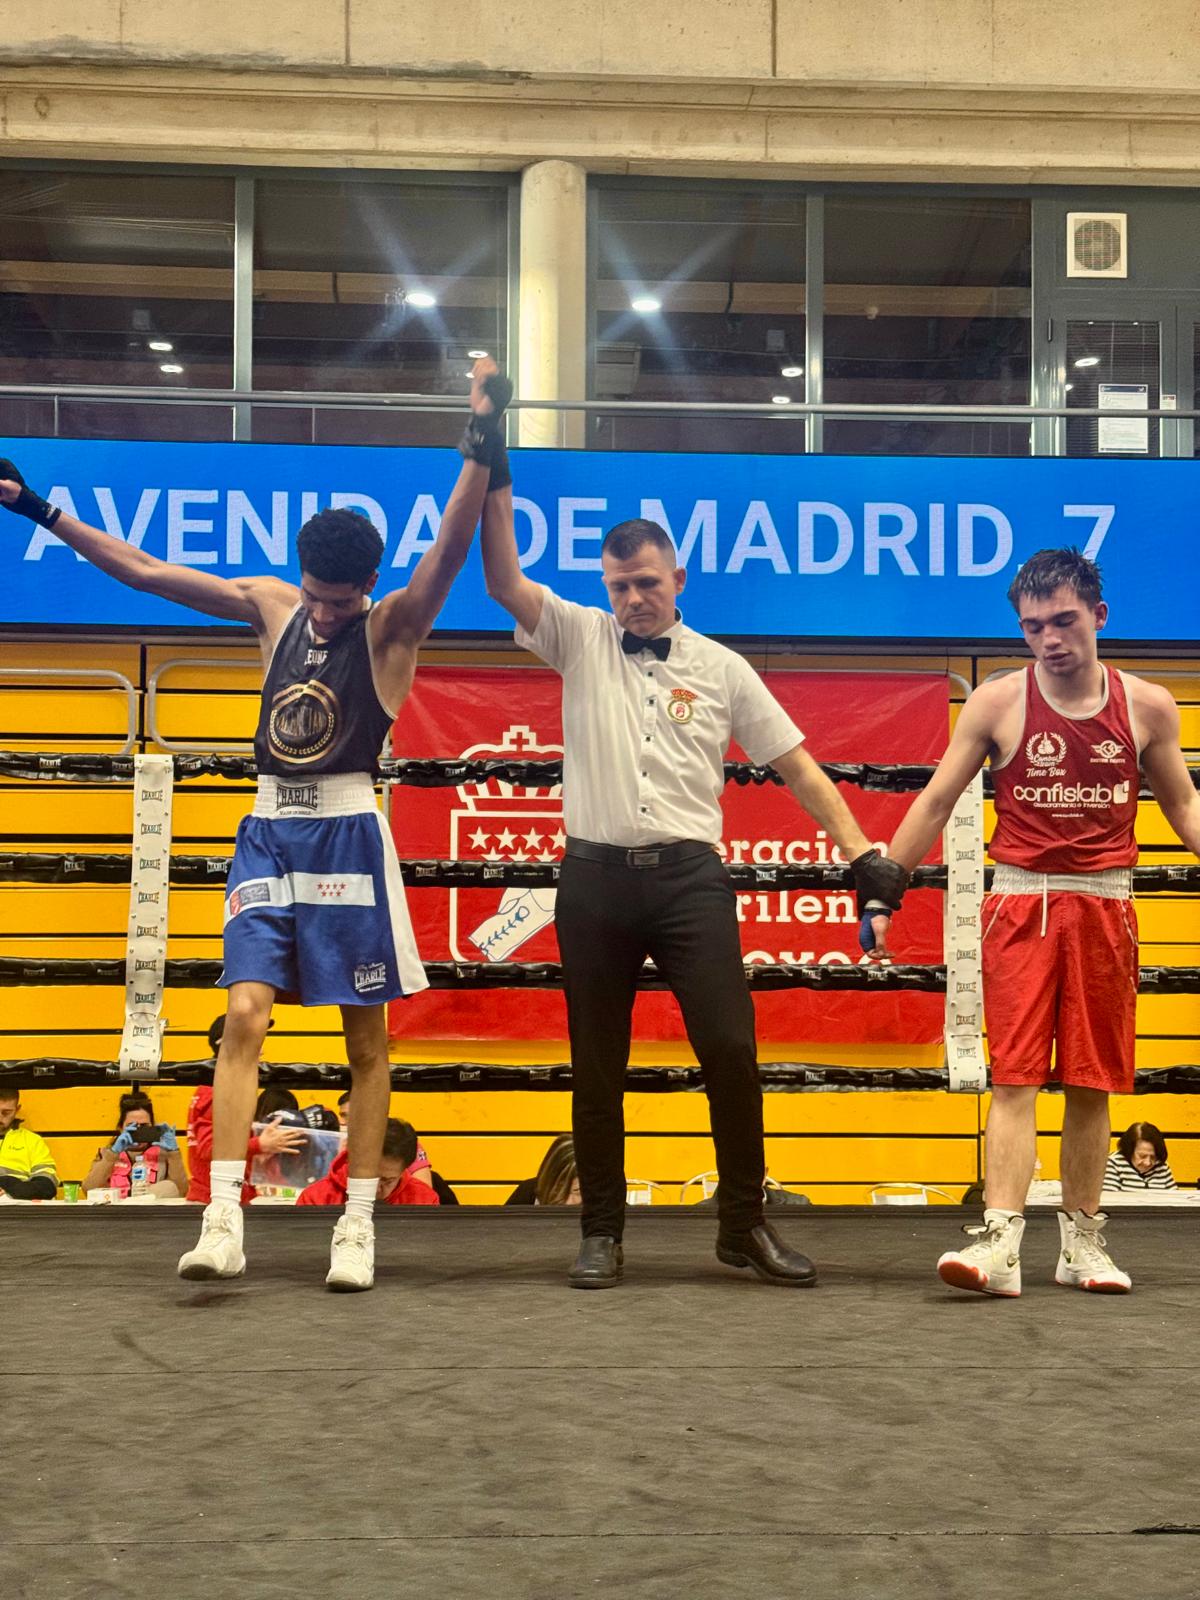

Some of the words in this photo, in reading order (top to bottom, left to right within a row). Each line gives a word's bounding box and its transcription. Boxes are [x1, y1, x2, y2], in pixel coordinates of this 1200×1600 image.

[512, 496, 608, 571] DE
[1063, 505, 1116, 564] 7
[1026, 768, 1047, 778] Time
[1048, 767, 1067, 777] Box
[141, 789, 163, 802] CHARLIE
[277, 783, 318, 810] CHARLIE
[1013, 782, 1112, 803] confislab
[140, 823, 163, 835] CHARLIE
[139, 858, 161, 870] CHARLIE
[138, 891, 160, 904] CHARLIE
[136, 925, 158, 938] CHARLIE
[956, 948, 977, 961] CHARLIE
[135, 959, 157, 971] CHARLIE
[354, 965, 386, 990] CHARLIE
[956, 981, 977, 993] CHARLIE
